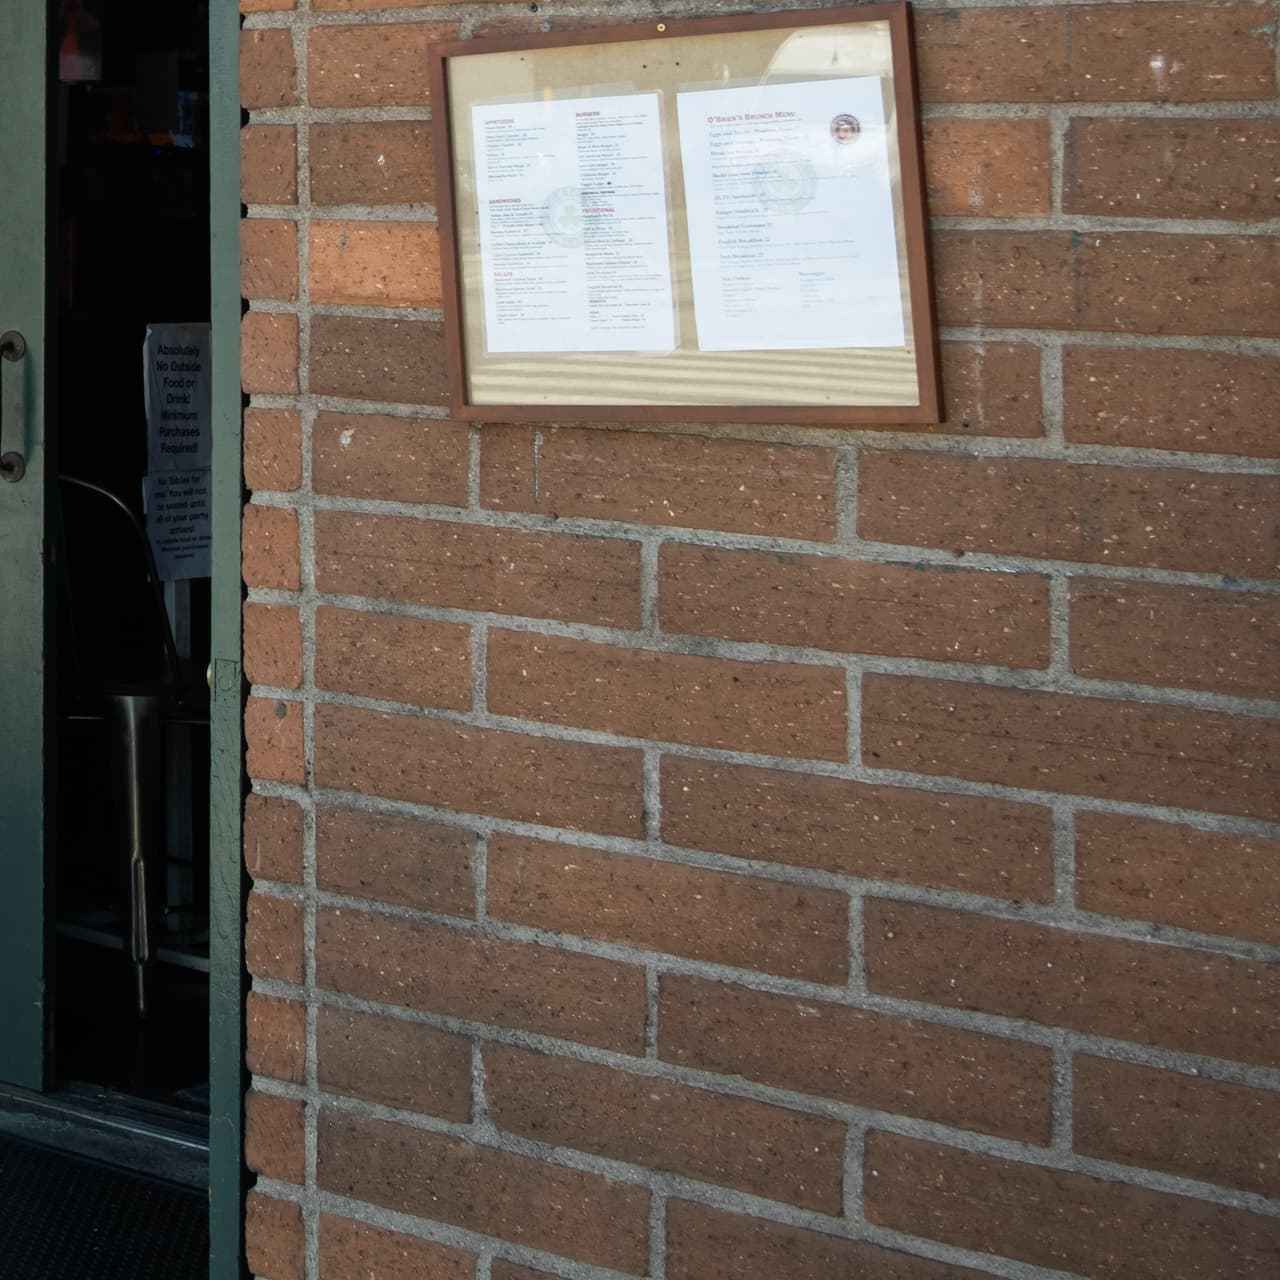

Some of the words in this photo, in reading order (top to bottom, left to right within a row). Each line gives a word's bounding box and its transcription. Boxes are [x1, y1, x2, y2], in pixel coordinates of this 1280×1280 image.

[157, 344, 201, 358] Absolutely
[156, 361, 169, 371] No
[170, 362, 202, 372] Outside
[163, 376, 184, 388] Food
[186, 378, 196, 388] or
[167, 393, 191, 405] Drink!
[160, 410, 198, 421] Minimum
[159, 426, 201, 438] Purchases
[160, 442, 198, 455] Required!
